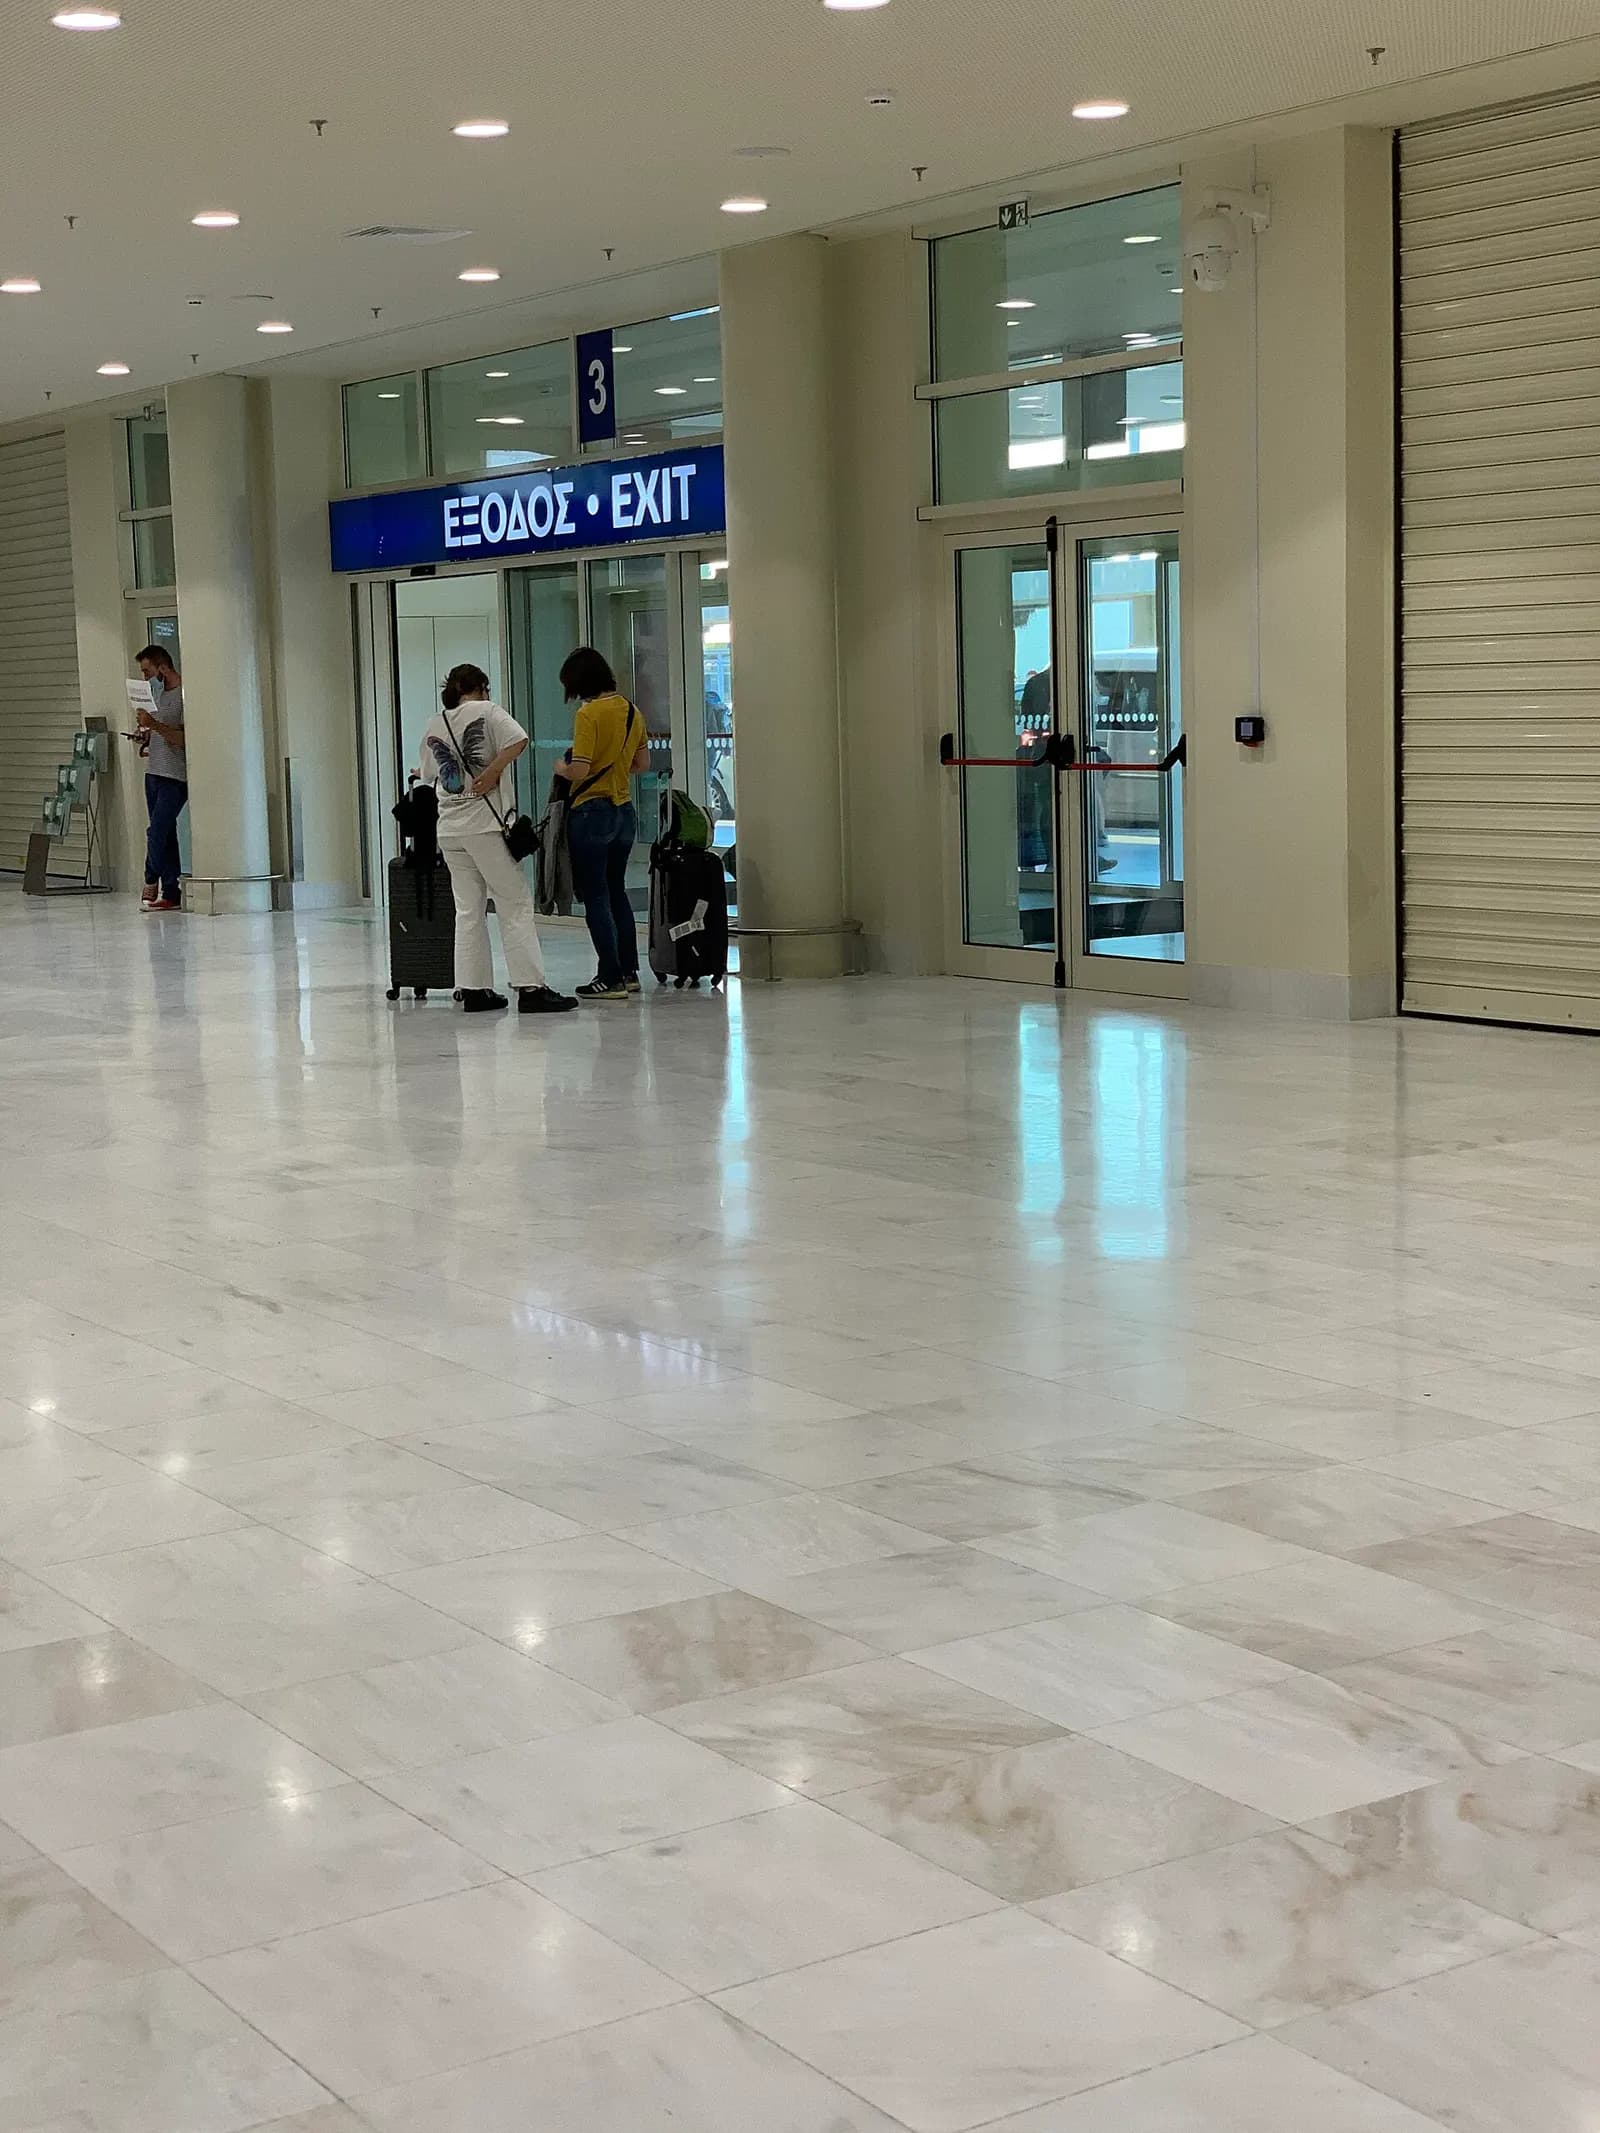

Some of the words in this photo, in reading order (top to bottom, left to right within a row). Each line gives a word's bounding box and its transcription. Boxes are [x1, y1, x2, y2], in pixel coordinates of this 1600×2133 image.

[588, 359, 607, 415] 3
[443, 481, 576, 549] ΕΞΟΔΟΣ
[611, 464, 697, 529] EXIT
